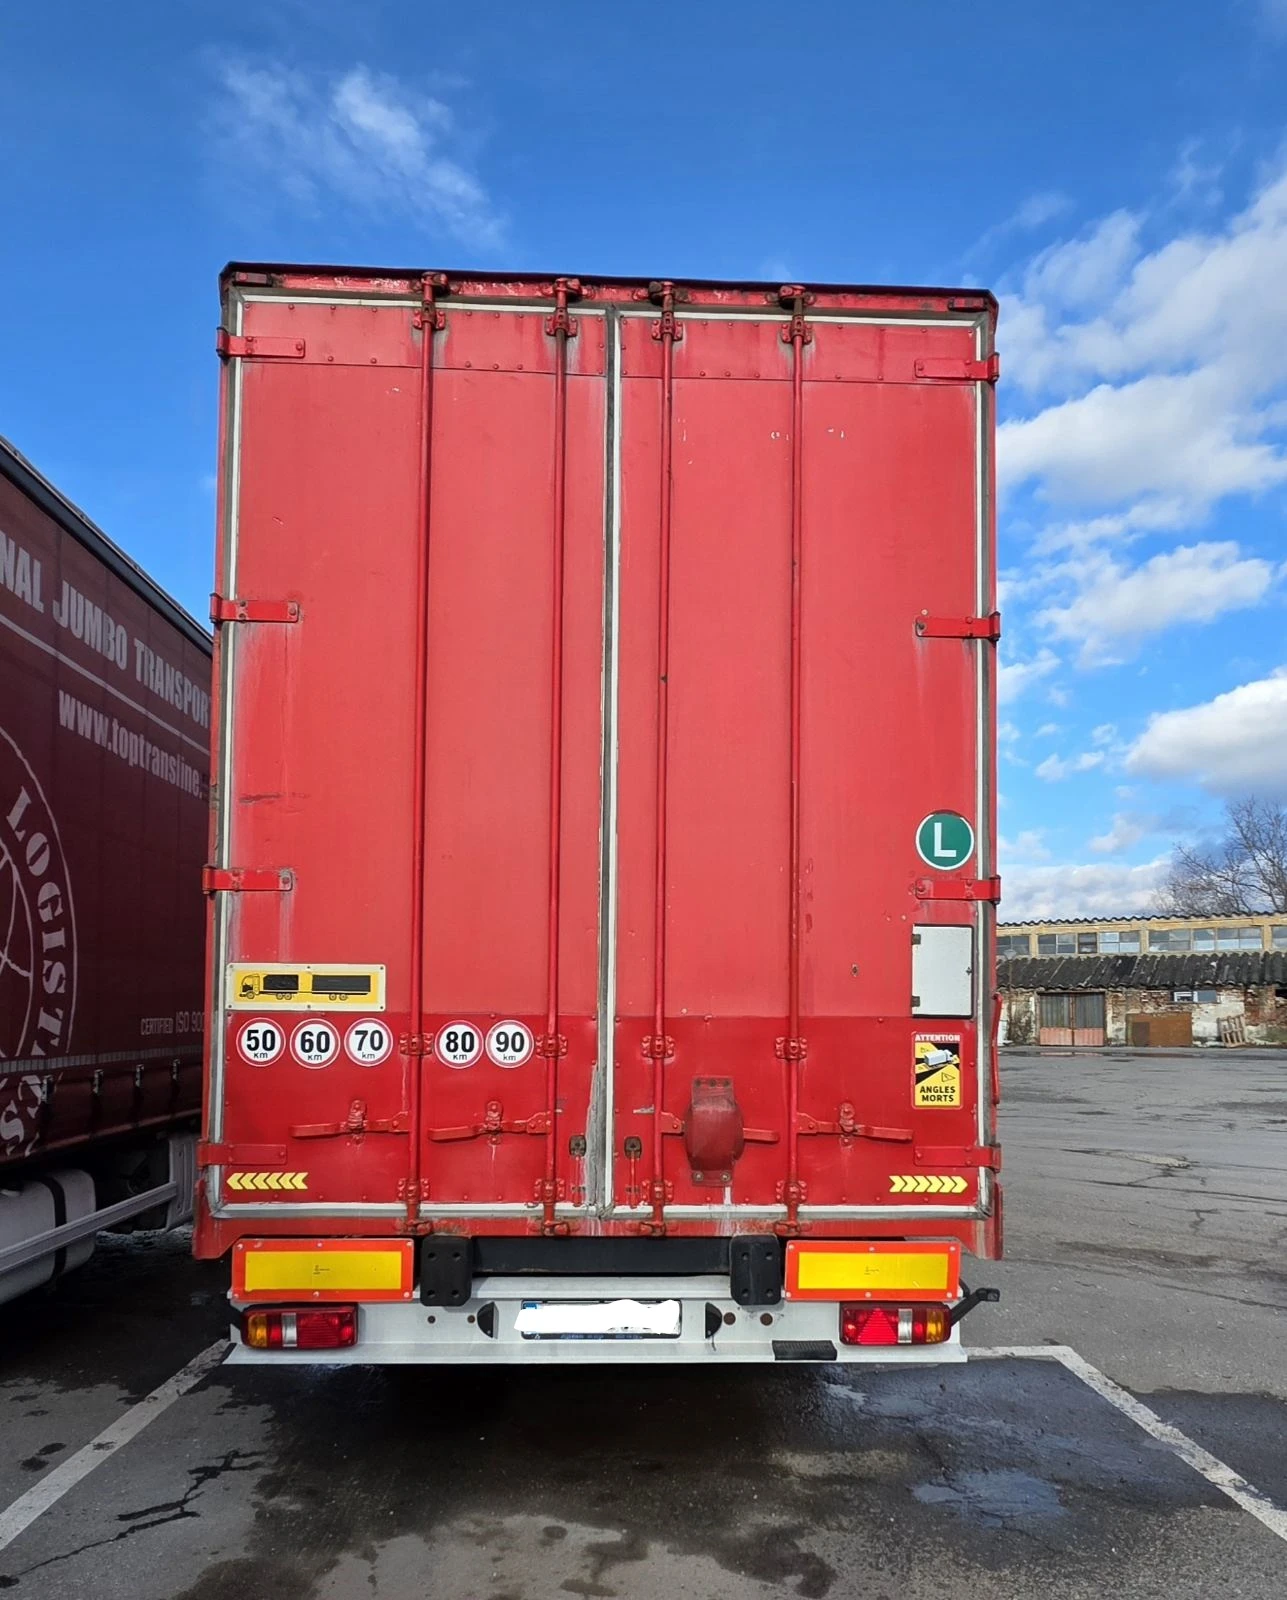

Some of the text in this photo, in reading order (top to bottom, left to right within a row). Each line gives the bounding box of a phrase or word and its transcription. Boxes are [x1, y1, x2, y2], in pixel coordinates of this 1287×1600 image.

[52, 580, 128, 671] JUMBO
[134, 638, 211, 729] TRANSPOR
[933, 822, 957, 858] L
[176, 1011, 189, 1033] ISO
[246, 1029, 276, 1051] 50
[300, 1031, 330, 1053] 60
[355, 1030, 384, 1051] 70
[446, 1031, 475, 1053] 80
[495, 1031, 525, 1053] 90
[915, 1034, 960, 1042] ATTENTION
[919, 1085, 956, 1094] ANGLES
[921, 1094, 955, 1103] MORTS
